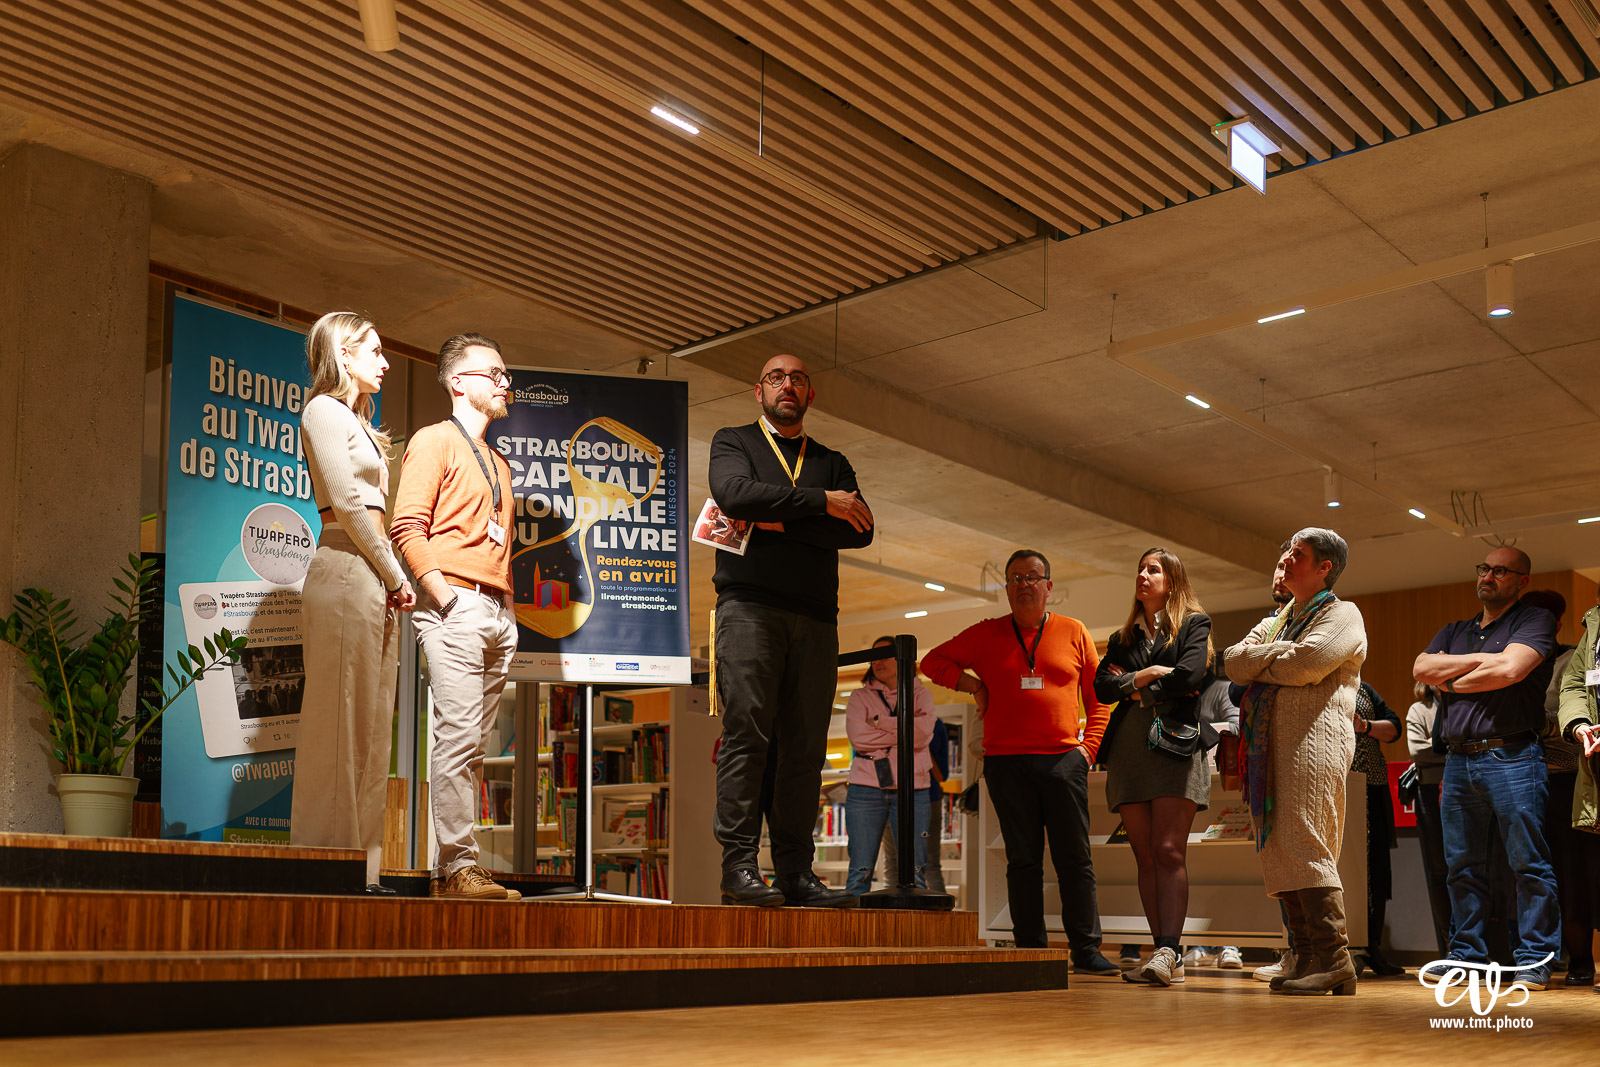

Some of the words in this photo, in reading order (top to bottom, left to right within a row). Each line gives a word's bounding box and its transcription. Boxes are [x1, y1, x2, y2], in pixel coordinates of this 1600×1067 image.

[515, 389, 569, 404] Strasbourg
[202, 403, 238, 440] au
[496, 436, 666, 464] STRASBOURG
[180, 438, 216, 479] de
[224, 447, 311, 500] Strasb
[668, 448, 677, 475] 2024
[668, 479, 677, 525] UNESCO
[512, 522, 538, 546] U
[593, 525, 677, 552] LIVRE
[251, 538, 311, 568] Strasbourg
[596, 554, 677, 568] Rendez-vous
[598, 569, 623, 582] en
[629, 568, 677, 584] avril
[220, 592, 245, 600] Twapéro
[246, 590, 277, 599] Strasbourg
[600, 592, 668, 603] lirenotremonde.
[239, 600, 273, 608] rendez-vous
[273, 598, 284, 606] des
[622, 602, 678, 612] strasbourg.eu
[282, 608, 302, 616] région.
[240, 721, 274, 730] Strasbourg.eu
[232, 760, 294, 782] @Twaper
[245, 816, 260, 826] AVEC
[260, 817, 268, 826] LE
[268, 818, 291, 828] SOUTIEN
